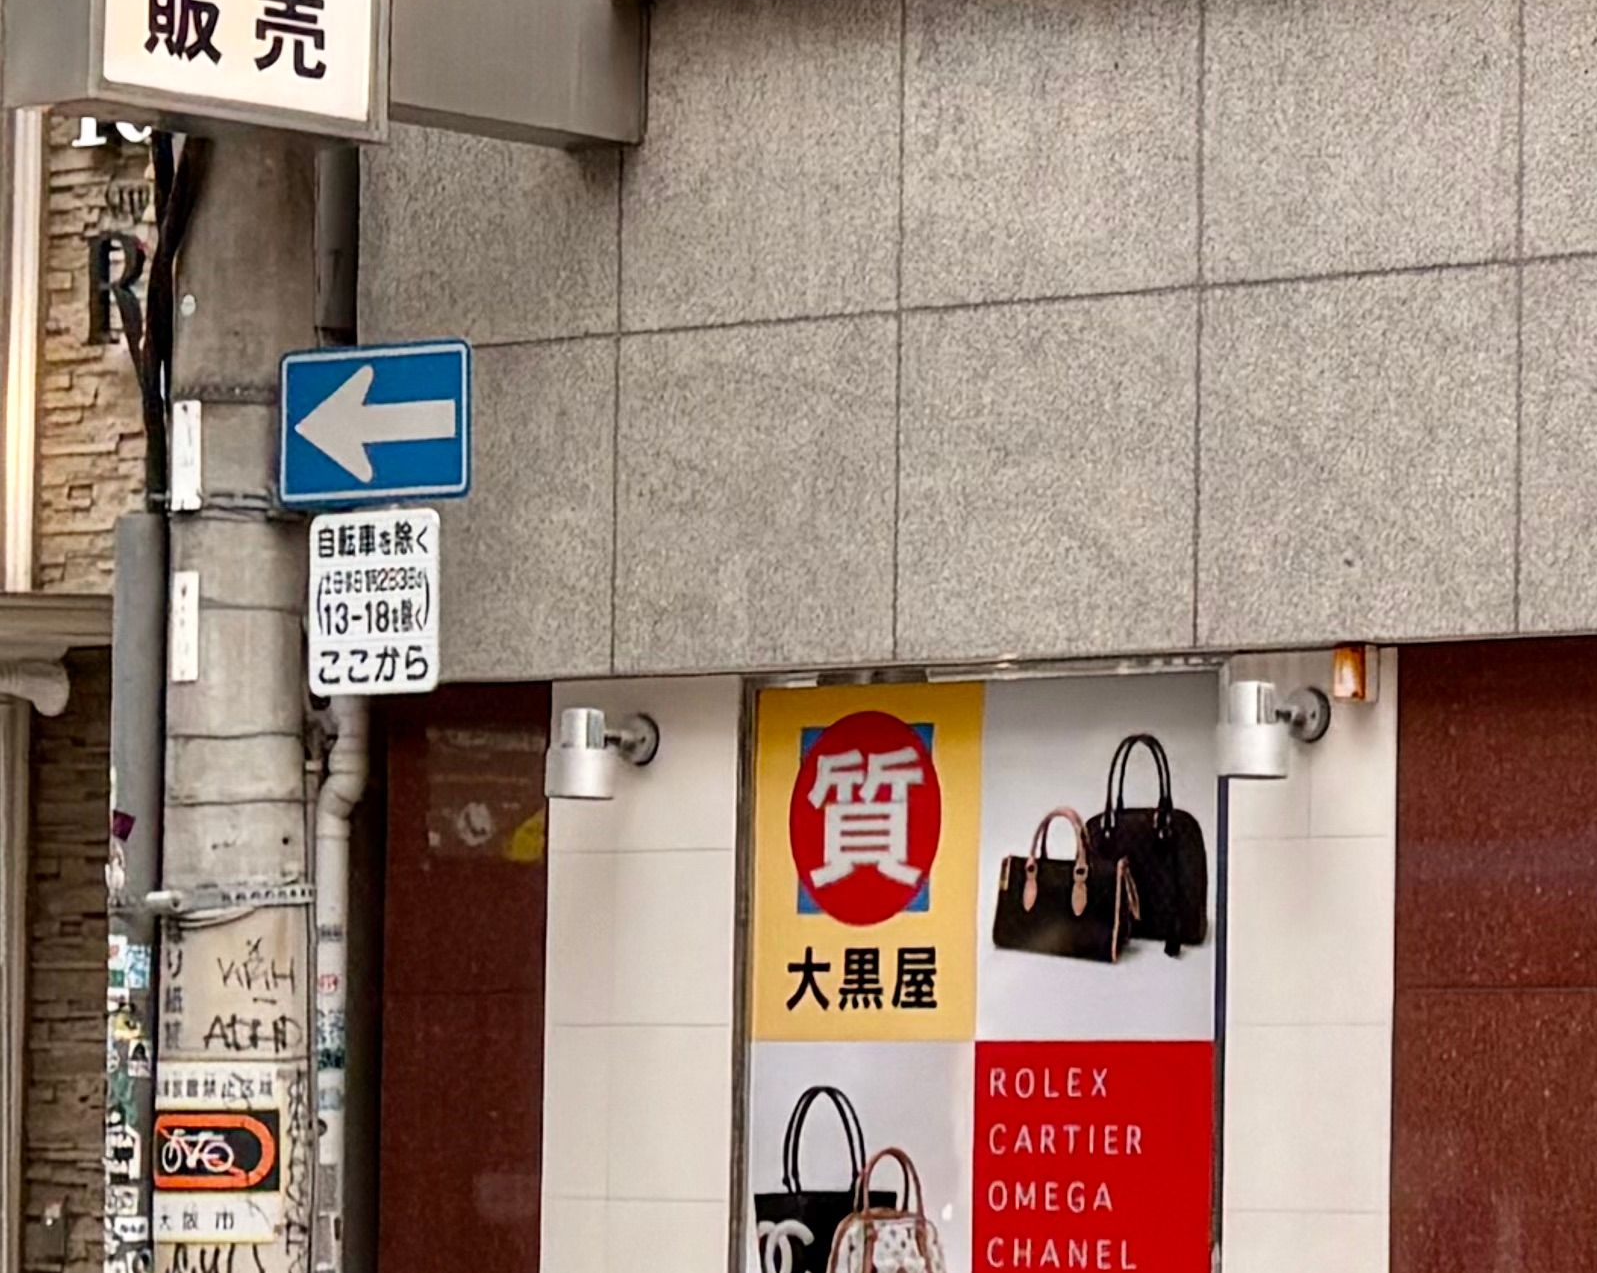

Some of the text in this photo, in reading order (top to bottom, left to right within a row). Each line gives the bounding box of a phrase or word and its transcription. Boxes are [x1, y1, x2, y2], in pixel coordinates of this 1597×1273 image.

[318, 521, 428, 558] 自転車を除く
[318, 645, 429, 685] ここから
[807, 746, 924, 888] 質
[786, 946, 938, 1011] 大黒屋
[989, 1067, 1108, 1099] ROLEX
[989, 1123, 1142, 1155] CARTIER
[988, 1181, 1113, 1213] OMEGA
[987, 1237, 1137, 1270] CHANEL
